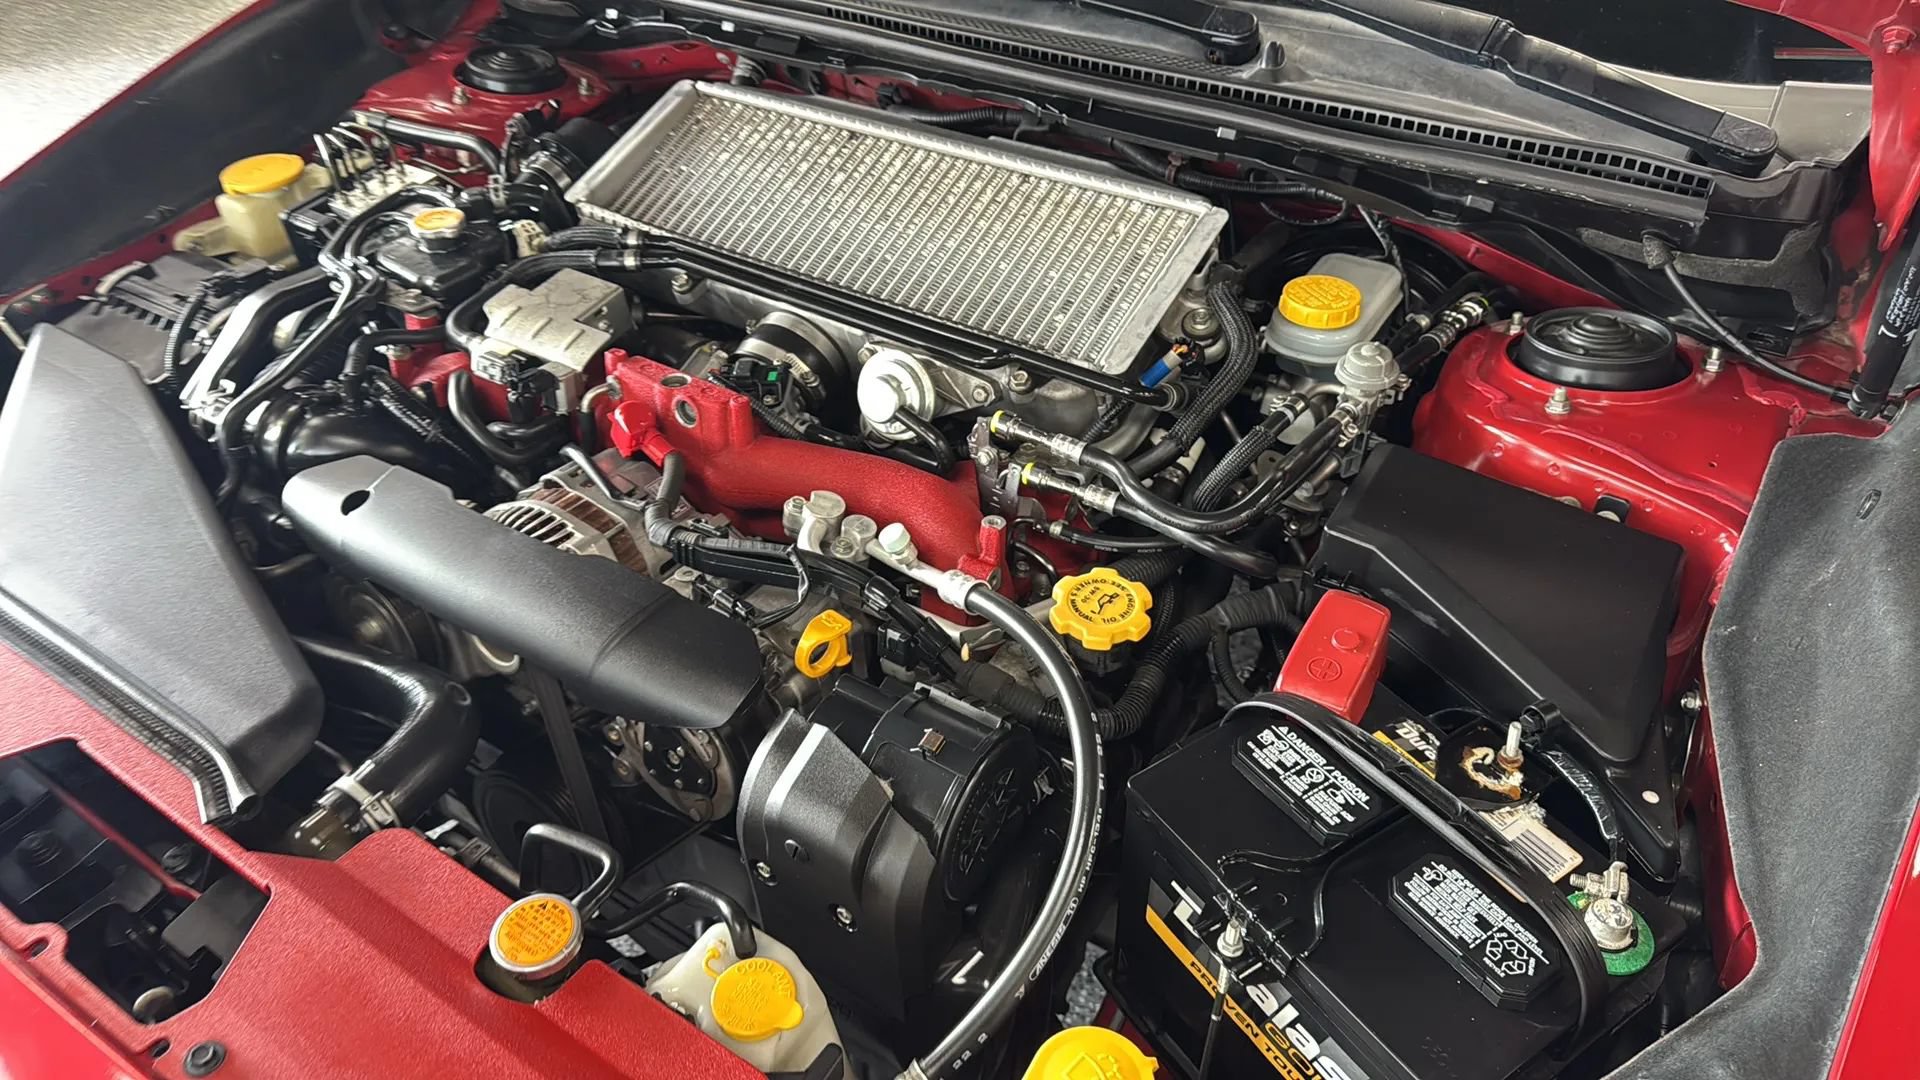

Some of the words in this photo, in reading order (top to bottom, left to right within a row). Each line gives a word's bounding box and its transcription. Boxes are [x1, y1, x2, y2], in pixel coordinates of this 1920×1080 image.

[1070, 598, 1095, 623] MANUAL
[1119, 592, 1136, 619] ENGINE
[1101, 616, 1117, 624] OIL
[1287, 732, 1327, 766] DANGER
[1330, 770, 1370, 802] POISON
[736, 960, 791, 998] COOLANT
